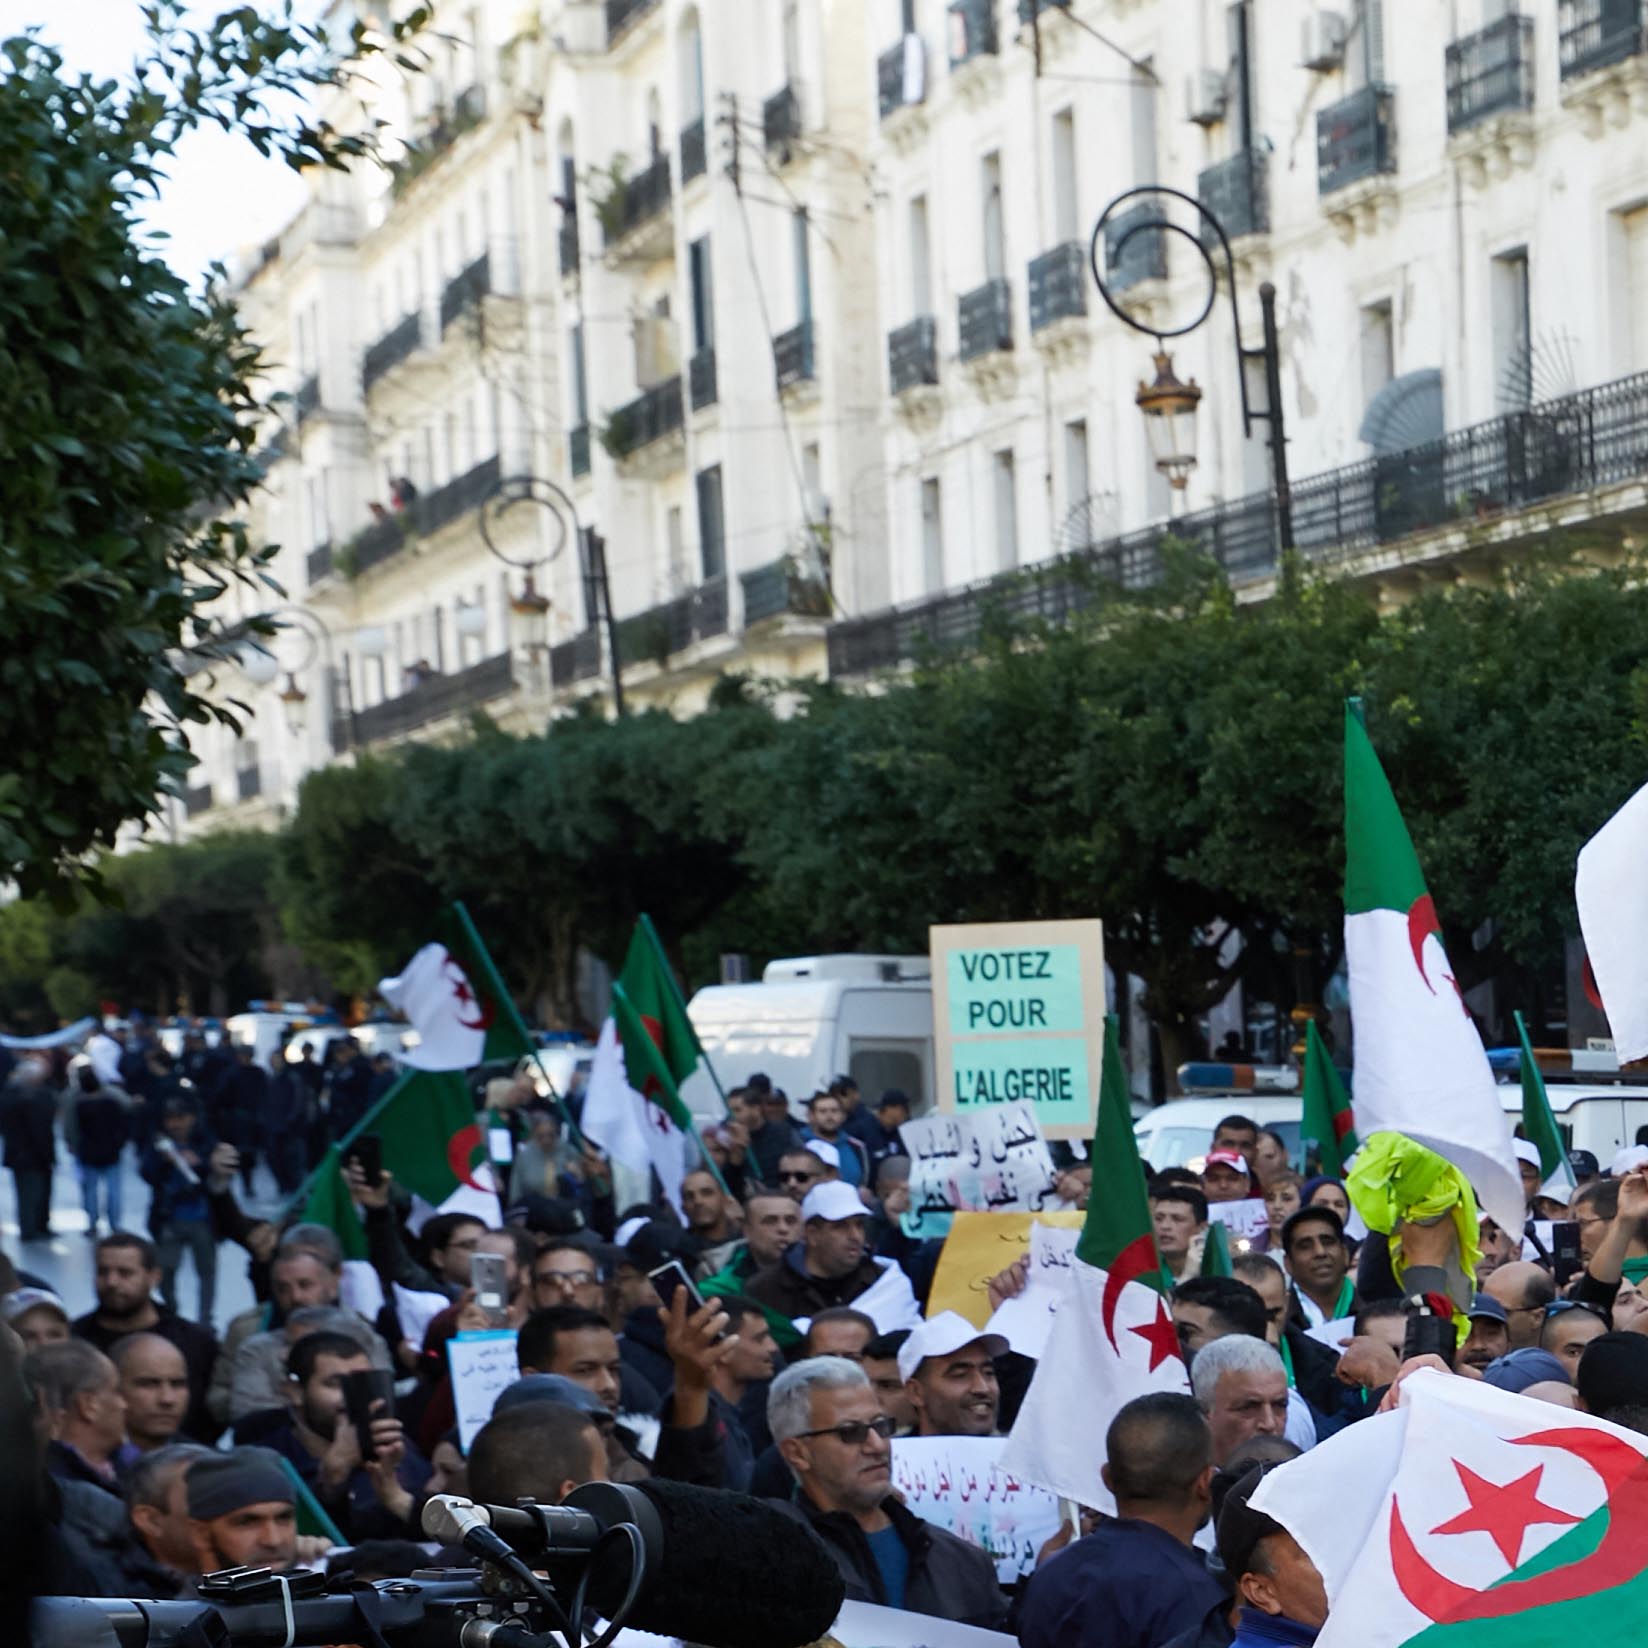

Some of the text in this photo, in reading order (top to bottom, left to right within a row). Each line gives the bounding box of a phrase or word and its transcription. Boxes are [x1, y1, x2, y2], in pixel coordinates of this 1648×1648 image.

[961, 950, 1052, 982] VOTEZ
[969, 998, 1047, 1029] POUR
[956, 1067, 1072, 1104] L'ALGERIE
